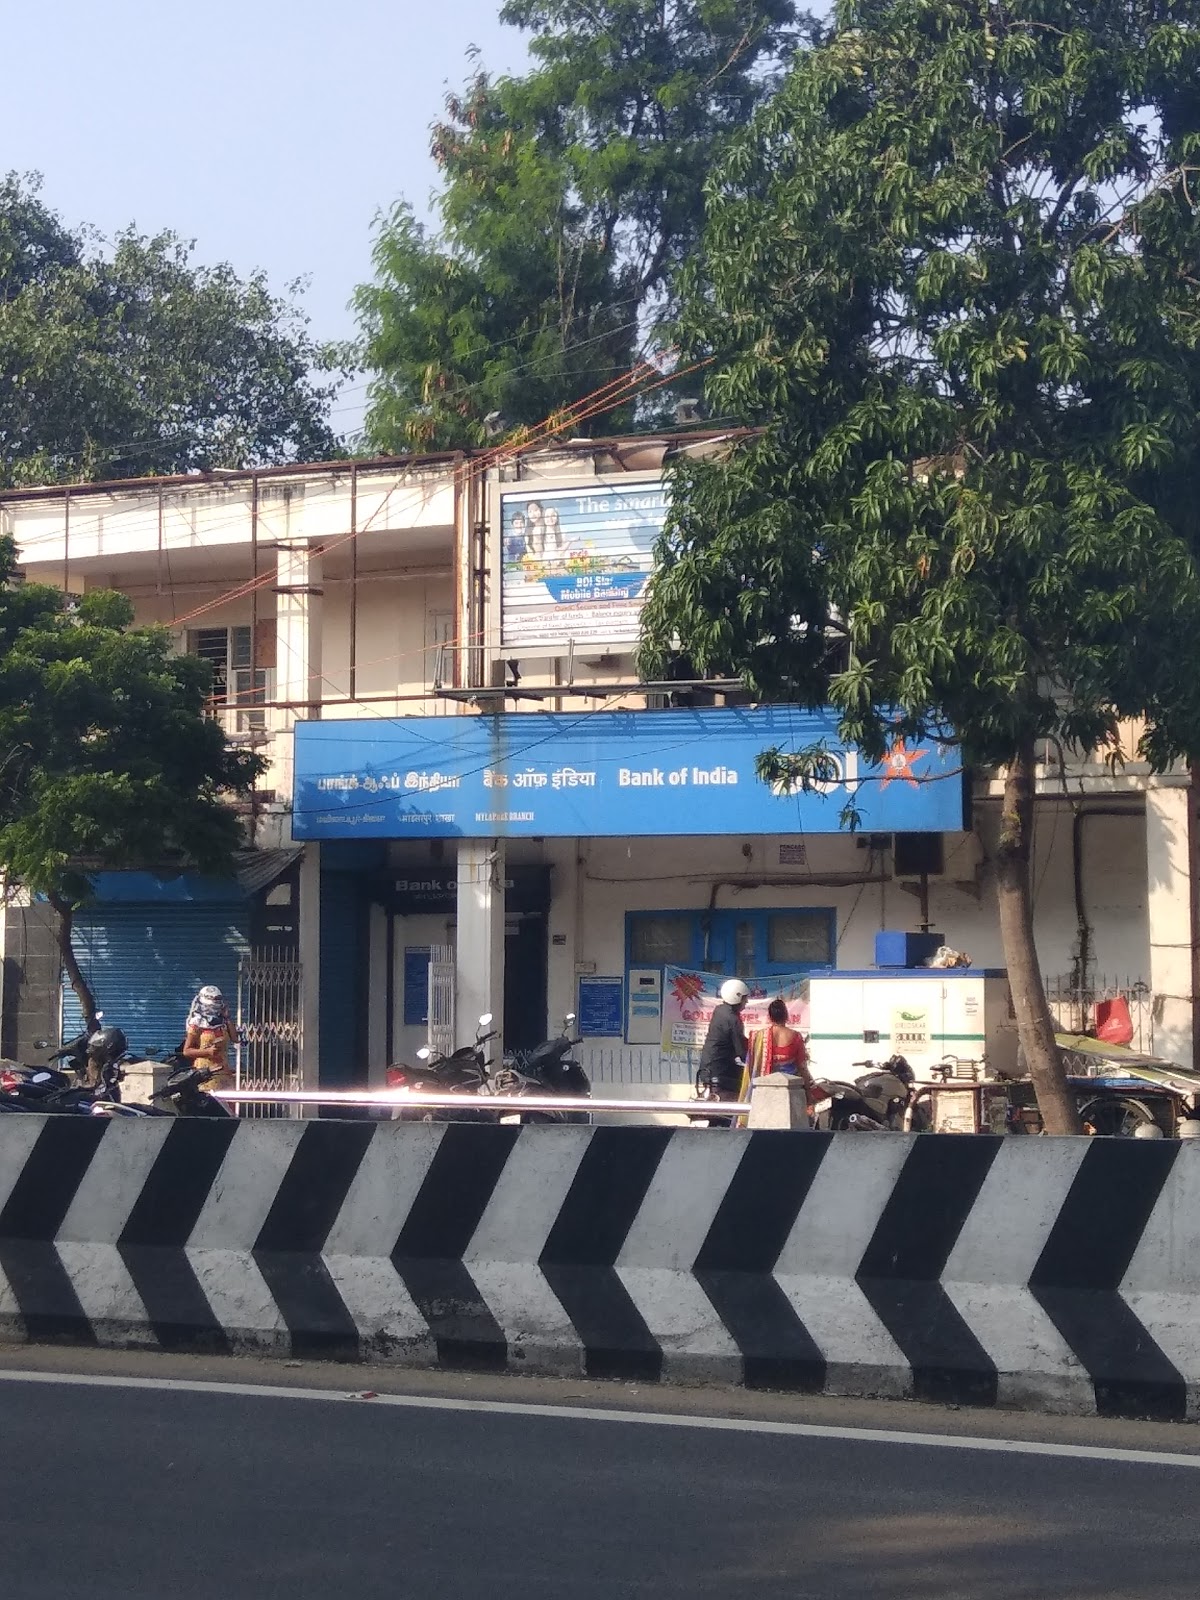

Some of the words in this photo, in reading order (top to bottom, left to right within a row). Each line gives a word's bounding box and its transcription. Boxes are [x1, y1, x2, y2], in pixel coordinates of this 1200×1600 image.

[575, 497, 610, 514] The
[560, 588, 591, 600] Mobile
[593, 586, 629, 599] Banking
[551, 767, 596, 790] इंडिया
[618, 767, 667, 786] Bank
[669, 768, 688, 786] of
[693, 766, 738, 785] India
[509, 811, 535, 822] BRANCH
[395, 879, 442, 892] Bank
